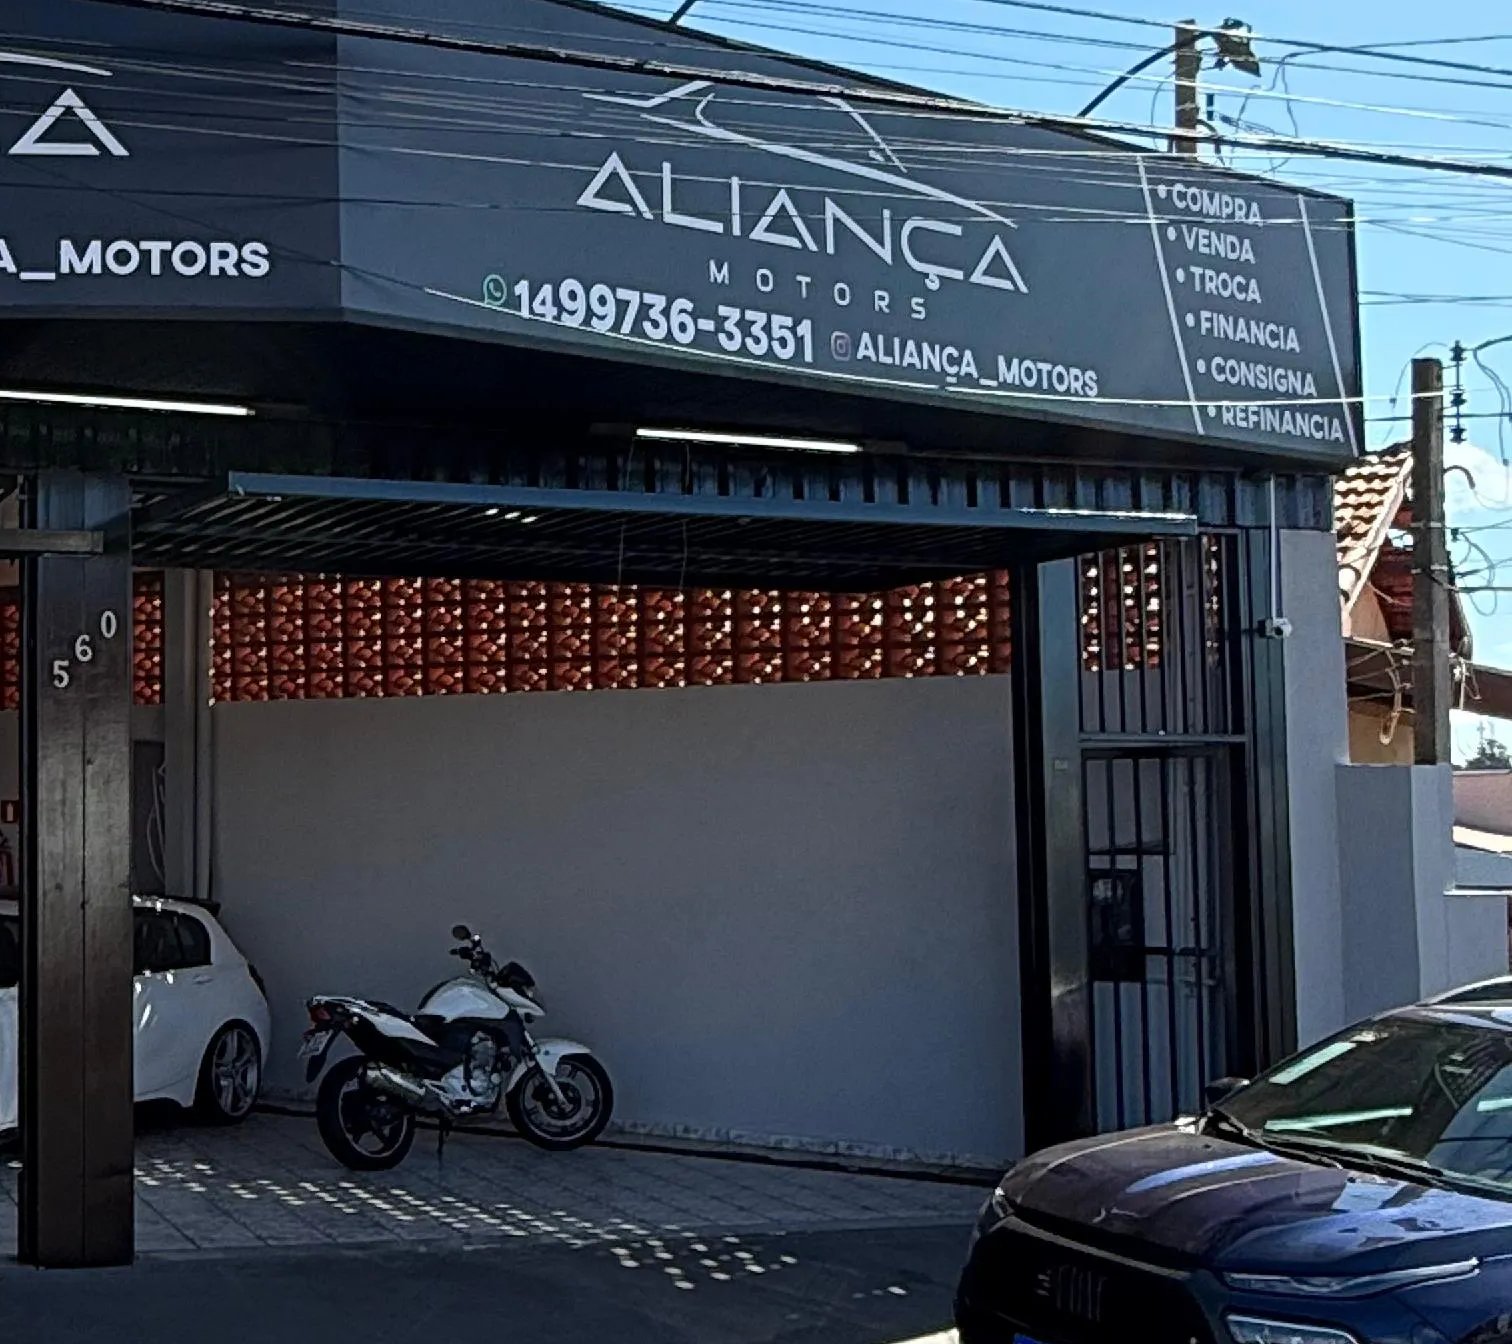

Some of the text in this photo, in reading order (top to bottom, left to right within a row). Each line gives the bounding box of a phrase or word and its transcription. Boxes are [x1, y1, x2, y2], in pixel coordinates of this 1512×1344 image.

[576, 151, 1029, 293] ALIANÇA
[1172, 182, 1264, 228] COMPRA
[1182, 224, 1256, 264] VENDA
[708, 259, 927, 320] MOTORS
[1190, 266, 1262, 304] TROCA
[513, 278, 814, 363] 1499736-3351
[1199, 310, 1300, 354] FINANCIA
[856, 332, 1098, 397] ALIANÇA_MOTORS
[1211, 356, 1317, 397] CONSIGNA
[1222, 405, 1344, 443] REFINANCIA
[53, 610, 117, 688] 560
